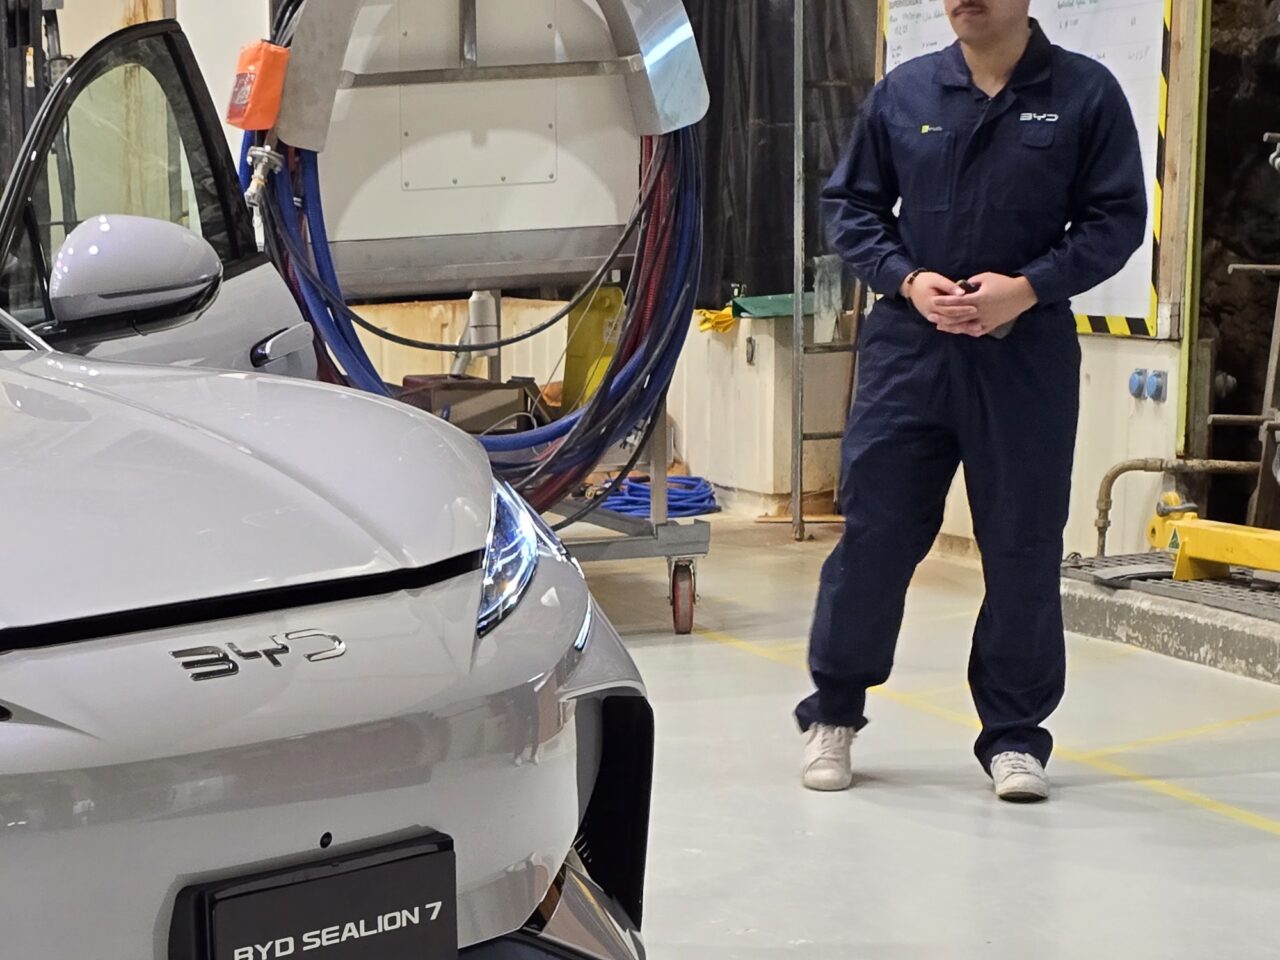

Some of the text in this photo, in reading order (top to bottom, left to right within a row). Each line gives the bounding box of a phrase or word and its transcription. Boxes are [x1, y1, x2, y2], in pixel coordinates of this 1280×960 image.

[1019, 112, 1059, 122] BYD
[169, 628, 347, 681] BYD
[302, 907, 419, 952] SEALION
[424, 901, 442, 921] 7
